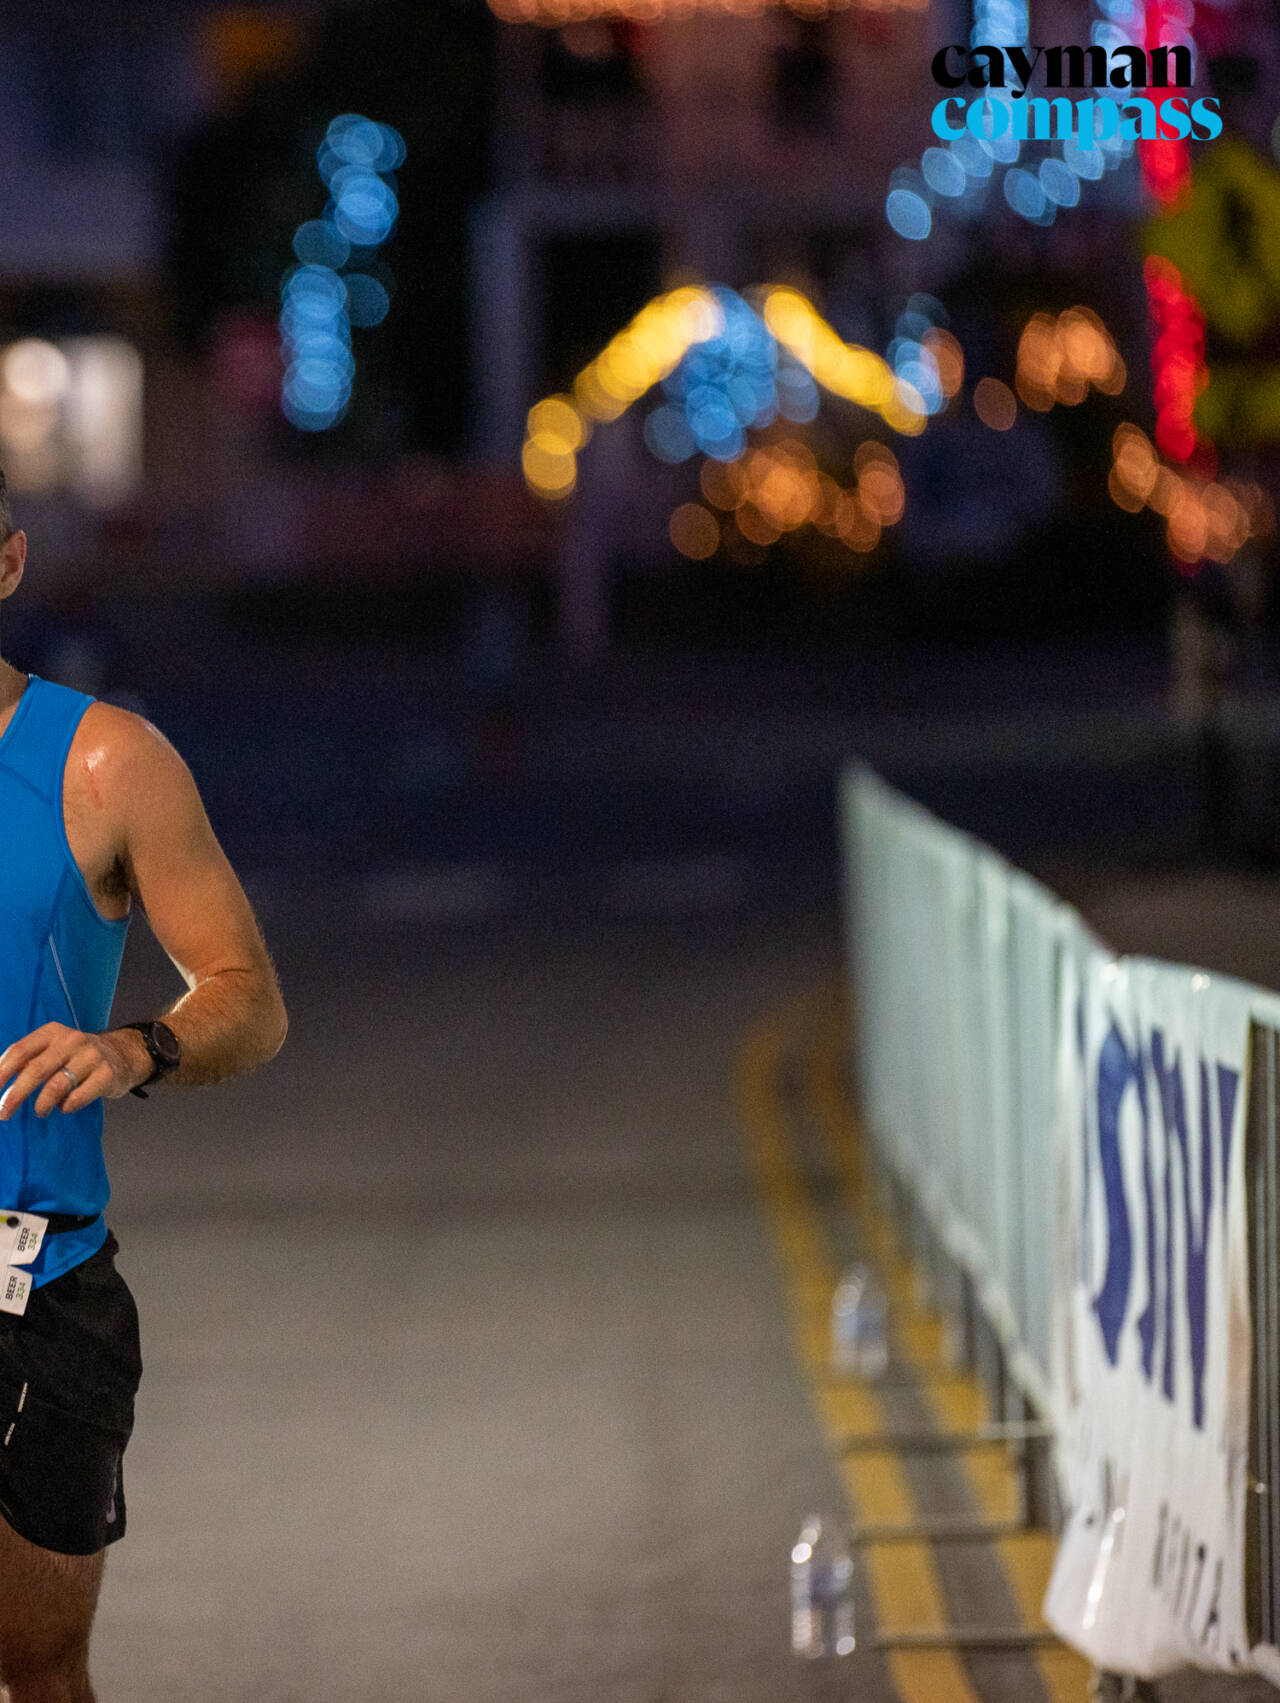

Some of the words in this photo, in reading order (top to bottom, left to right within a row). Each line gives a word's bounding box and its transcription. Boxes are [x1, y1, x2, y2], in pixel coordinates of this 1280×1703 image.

[17, 1227, 31, 1251] BEER
[28, 1232, 37, 1250] 334
[5, 1275, 18, 1300] BEER
[16, 1282, 25, 1300] 334
